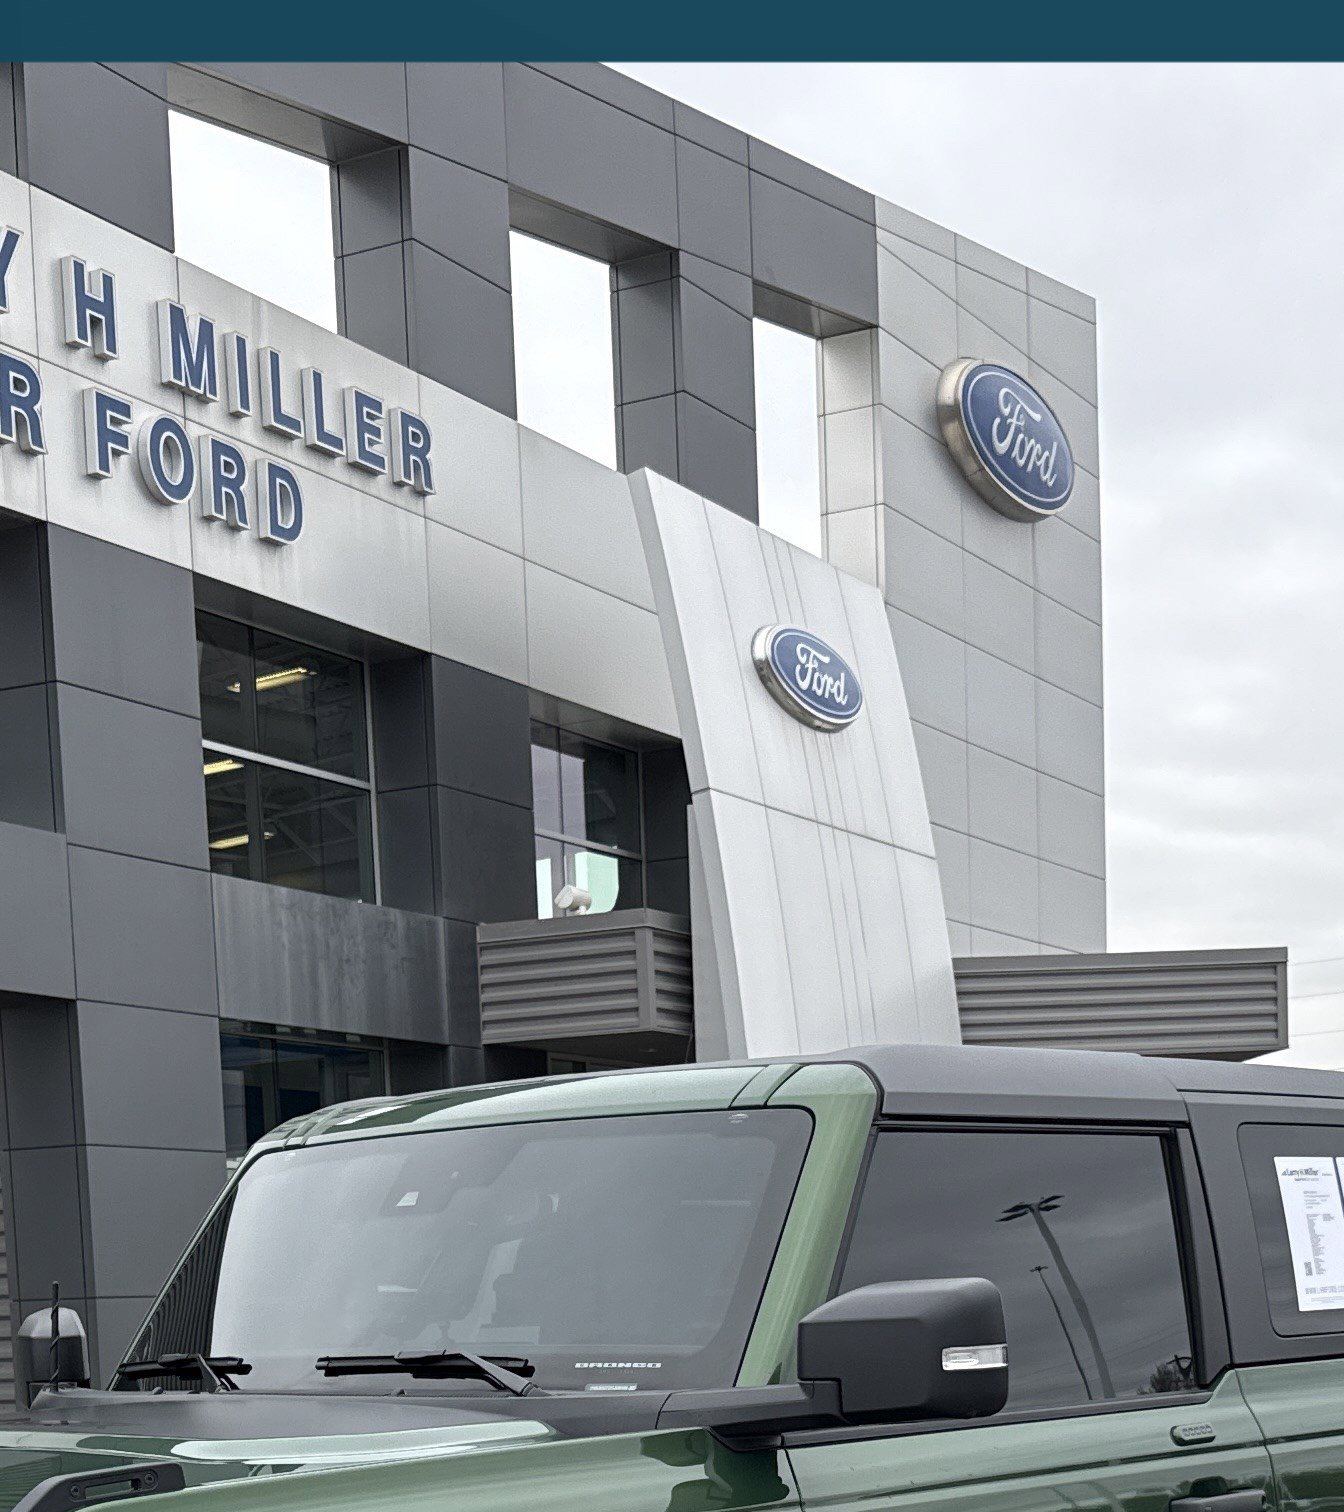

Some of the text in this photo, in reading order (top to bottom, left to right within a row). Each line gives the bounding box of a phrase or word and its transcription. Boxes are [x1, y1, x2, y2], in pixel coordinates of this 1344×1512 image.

[60, 254, 118, 360] H
[157, 297, 437, 496] MILLER
[992, 386, 1058, 488] Ford
[83, 386, 304, 546] FORD
[794, 642, 849, 706] Ford
